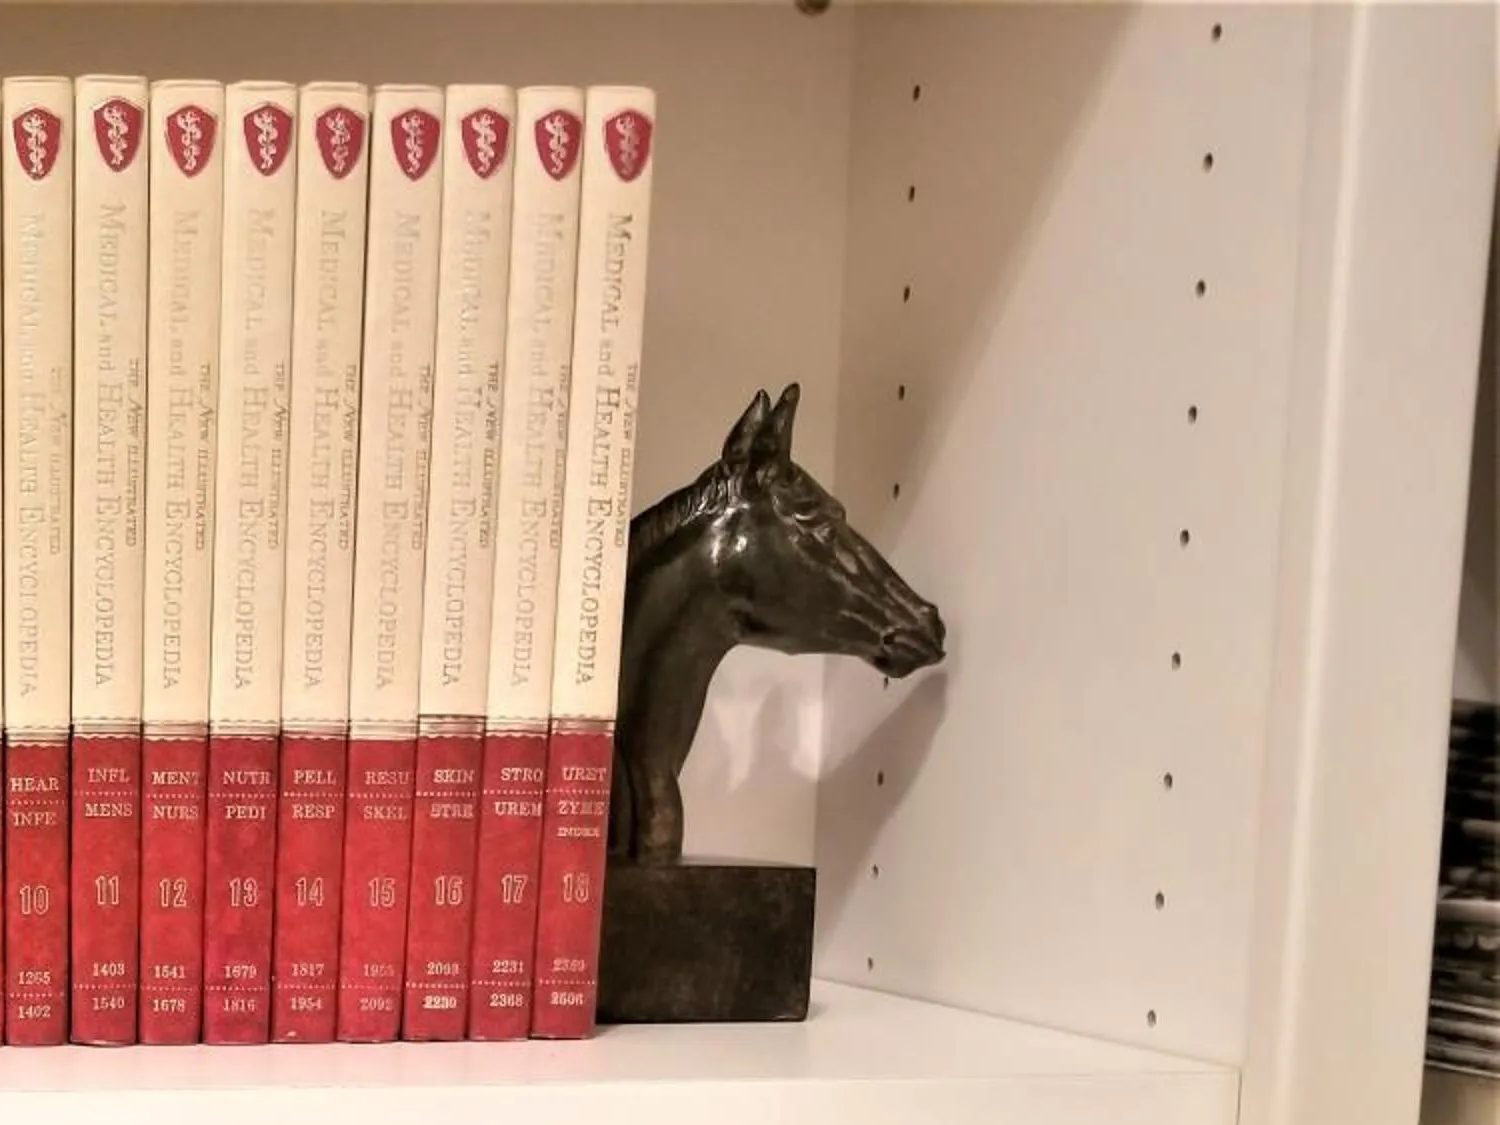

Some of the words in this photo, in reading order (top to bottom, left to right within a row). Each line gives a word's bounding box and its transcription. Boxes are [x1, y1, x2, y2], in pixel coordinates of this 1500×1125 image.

[99, 203, 127, 328] MEDICAL
[600, 213, 633, 331] MEDICAL
[97, 382, 124, 486] HEALTH
[591, 386, 620, 488] HEALTH
[95, 496, 122, 688] ENCYCLOPEDIA
[163, 499, 191, 690] ENCYCLOPEDIA
[234, 498, 264, 690] ENCYCLOPEDIA
[304, 499, 335, 688] ENCYCLOPEDIA
[376, 499, 409, 690] ENCYCLOPEDIA
[441, 497, 477, 688] ENCYCLOPEDIA
[511, 499, 547, 688] ENCYCLOPEDIA
[575, 498, 613, 685] ENCYCLOPEDIA
[9, 777, 60, 792] HEAR
[88, 768, 130, 783] INFL
[151, 771, 199, 785] MENT
[222, 771, 271, 785] NUTR
[293, 770, 337, 785] PELL
[365, 771, 409, 785] RESU
[433, 769, 475, 784] SKIN
[501, 768, 544, 781] STRO
[84, 803, 133, 817] MENS
[152, 805, 199, 819] NURS
[225, 805, 266, 819] PEDI
[292, 804, 336, 819] RESP
[363, 805, 407, 820] SKEL
[495, 802, 542, 817] UREM
[19, 884, 49, 915] 10
[95, 875, 120, 906] 11
[159, 878, 187, 908] 12
[229, 877, 258, 907] 13
[296, 877, 324, 907] 14
[369, 877, 396, 908] 15
[435, 875, 464, 906] 16
[501, 873, 528, 904] 17
[563, 872, 590, 902] 18
[492, 959, 524, 974] 2231
[18, 1005, 51, 1019] 1402
